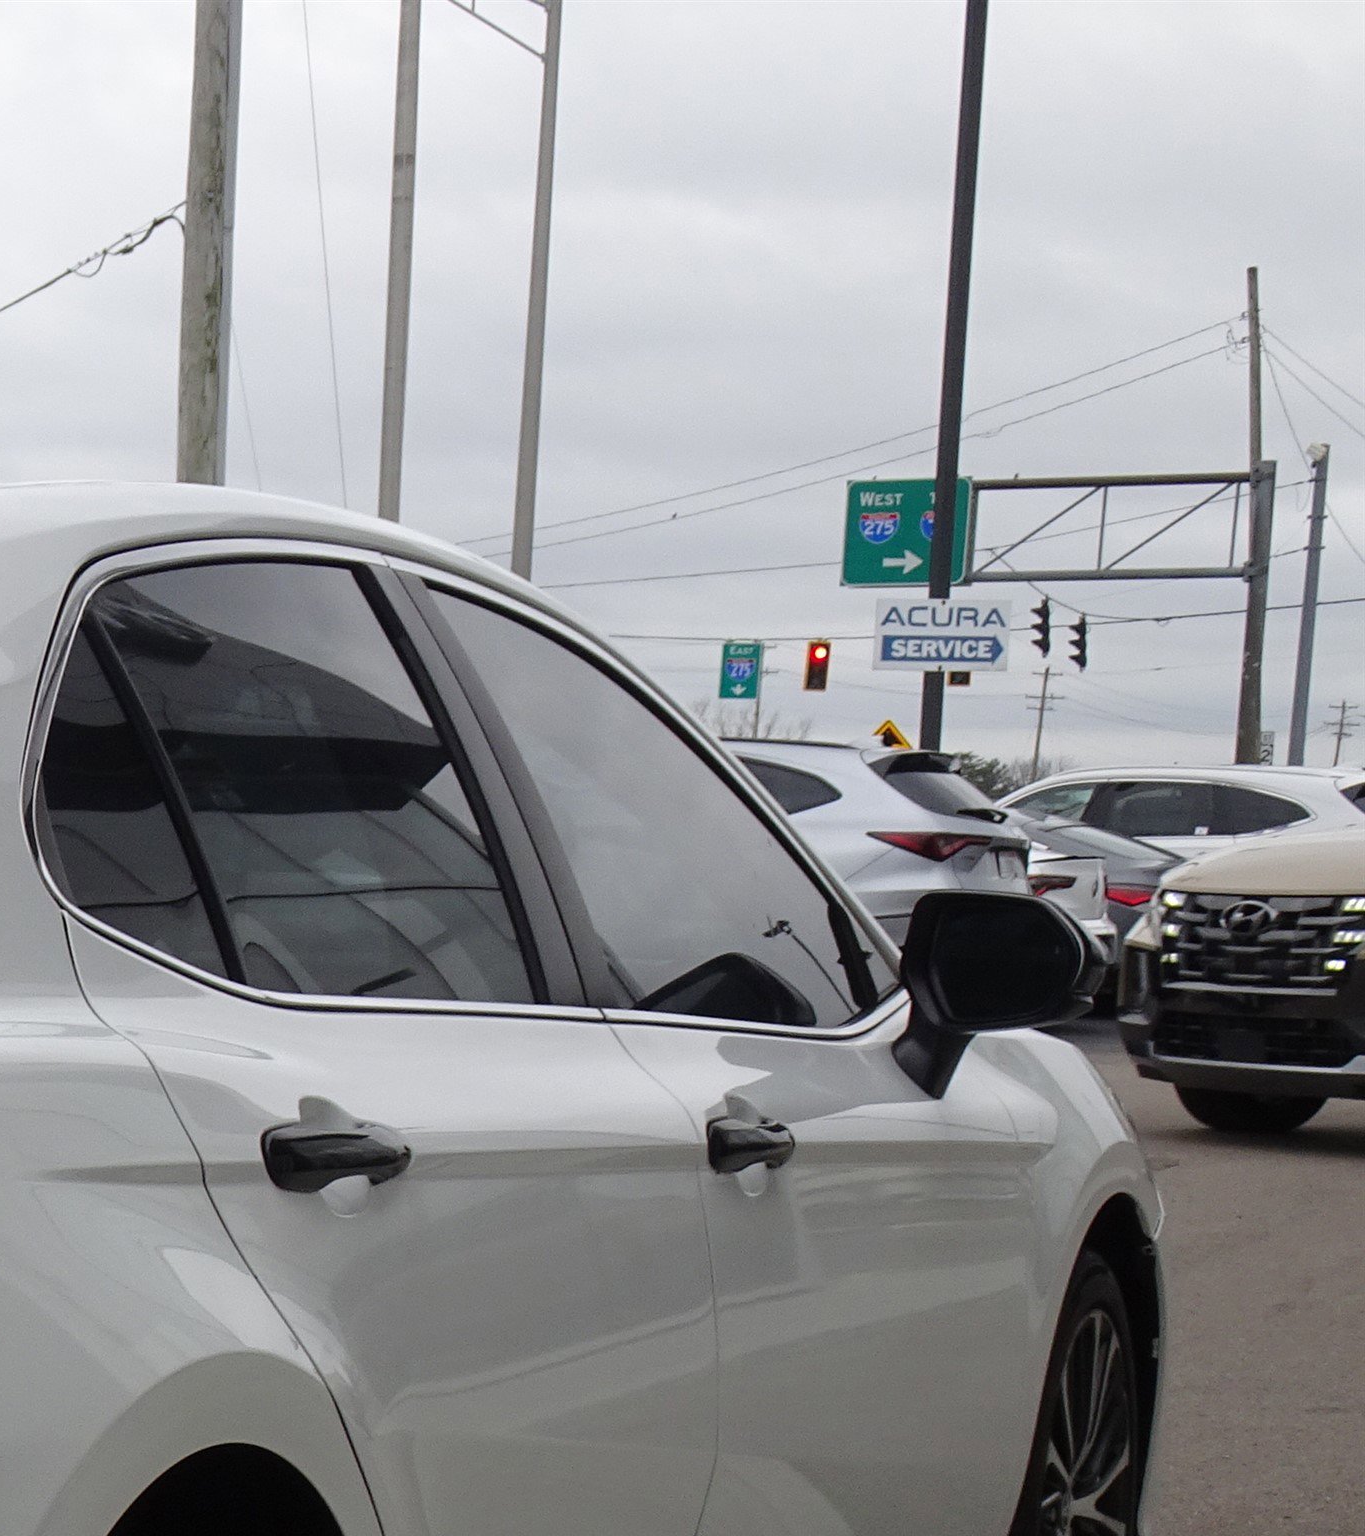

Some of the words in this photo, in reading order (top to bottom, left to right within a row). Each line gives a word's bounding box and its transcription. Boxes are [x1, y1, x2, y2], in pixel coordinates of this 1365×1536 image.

[859, 491, 904, 506] WEST
[863, 520, 895, 535] 275
[880, 606, 1006, 628] ACURA
[890, 639, 994, 659] SERVICE
